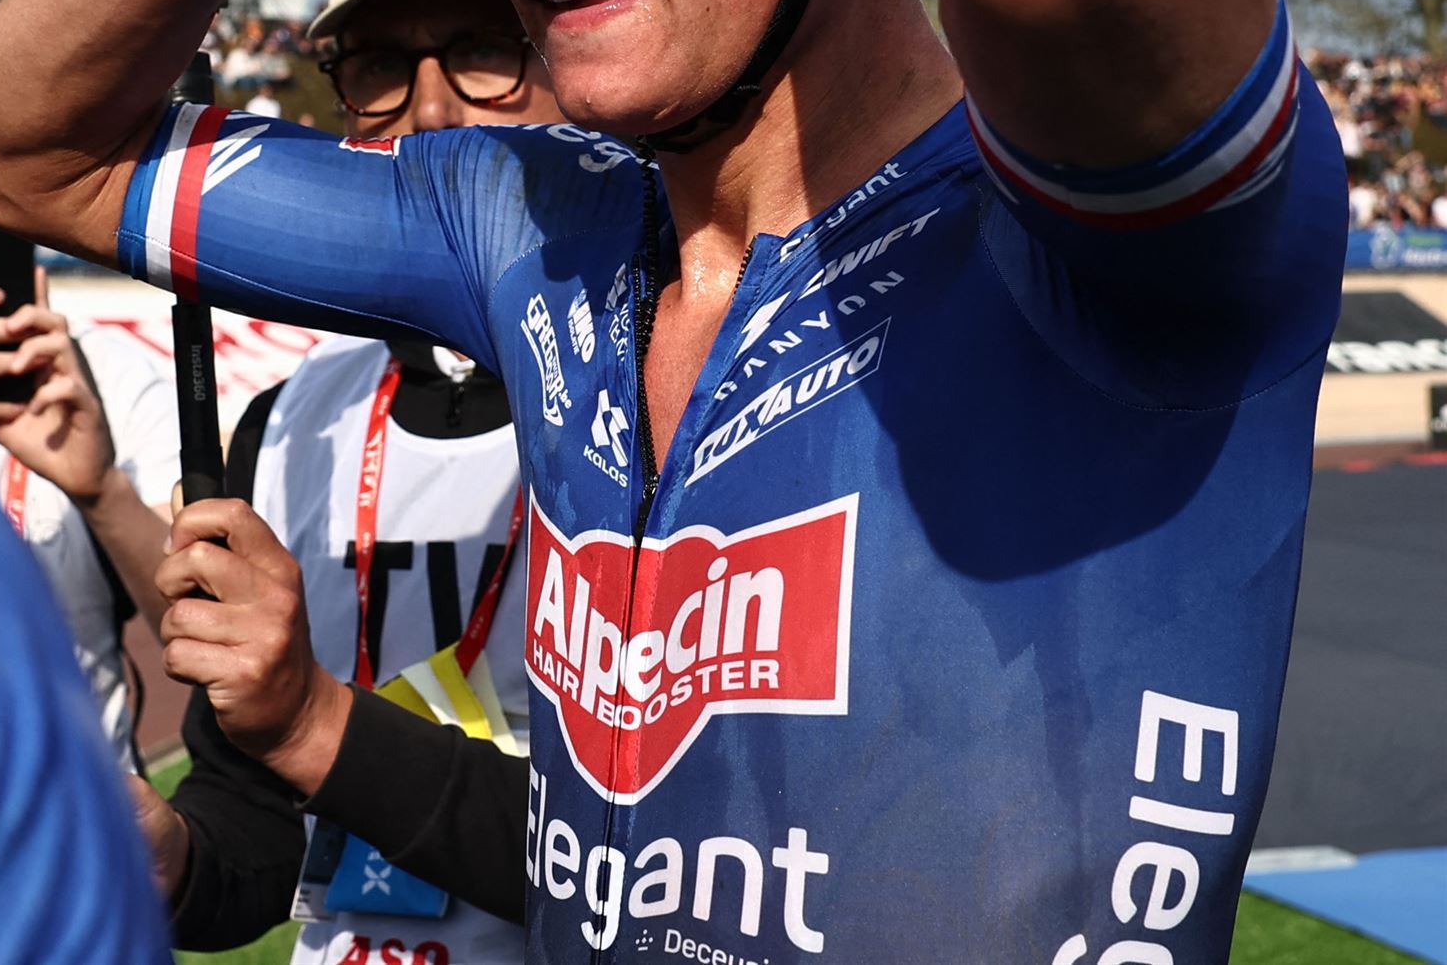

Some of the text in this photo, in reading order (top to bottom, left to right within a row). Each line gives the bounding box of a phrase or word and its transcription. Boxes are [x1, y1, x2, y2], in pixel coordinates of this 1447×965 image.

[798, 207, 941, 300] ZWIFT
[191, 344, 207, 402] Insta360
[713, 270, 905, 402] CANYON
[343, 540, 520, 683] TV
[533, 546, 785, 716] Alpecin
[532, 638, 781, 731] HAIR BOOSTER
[526, 759, 830, 954] Elegant
